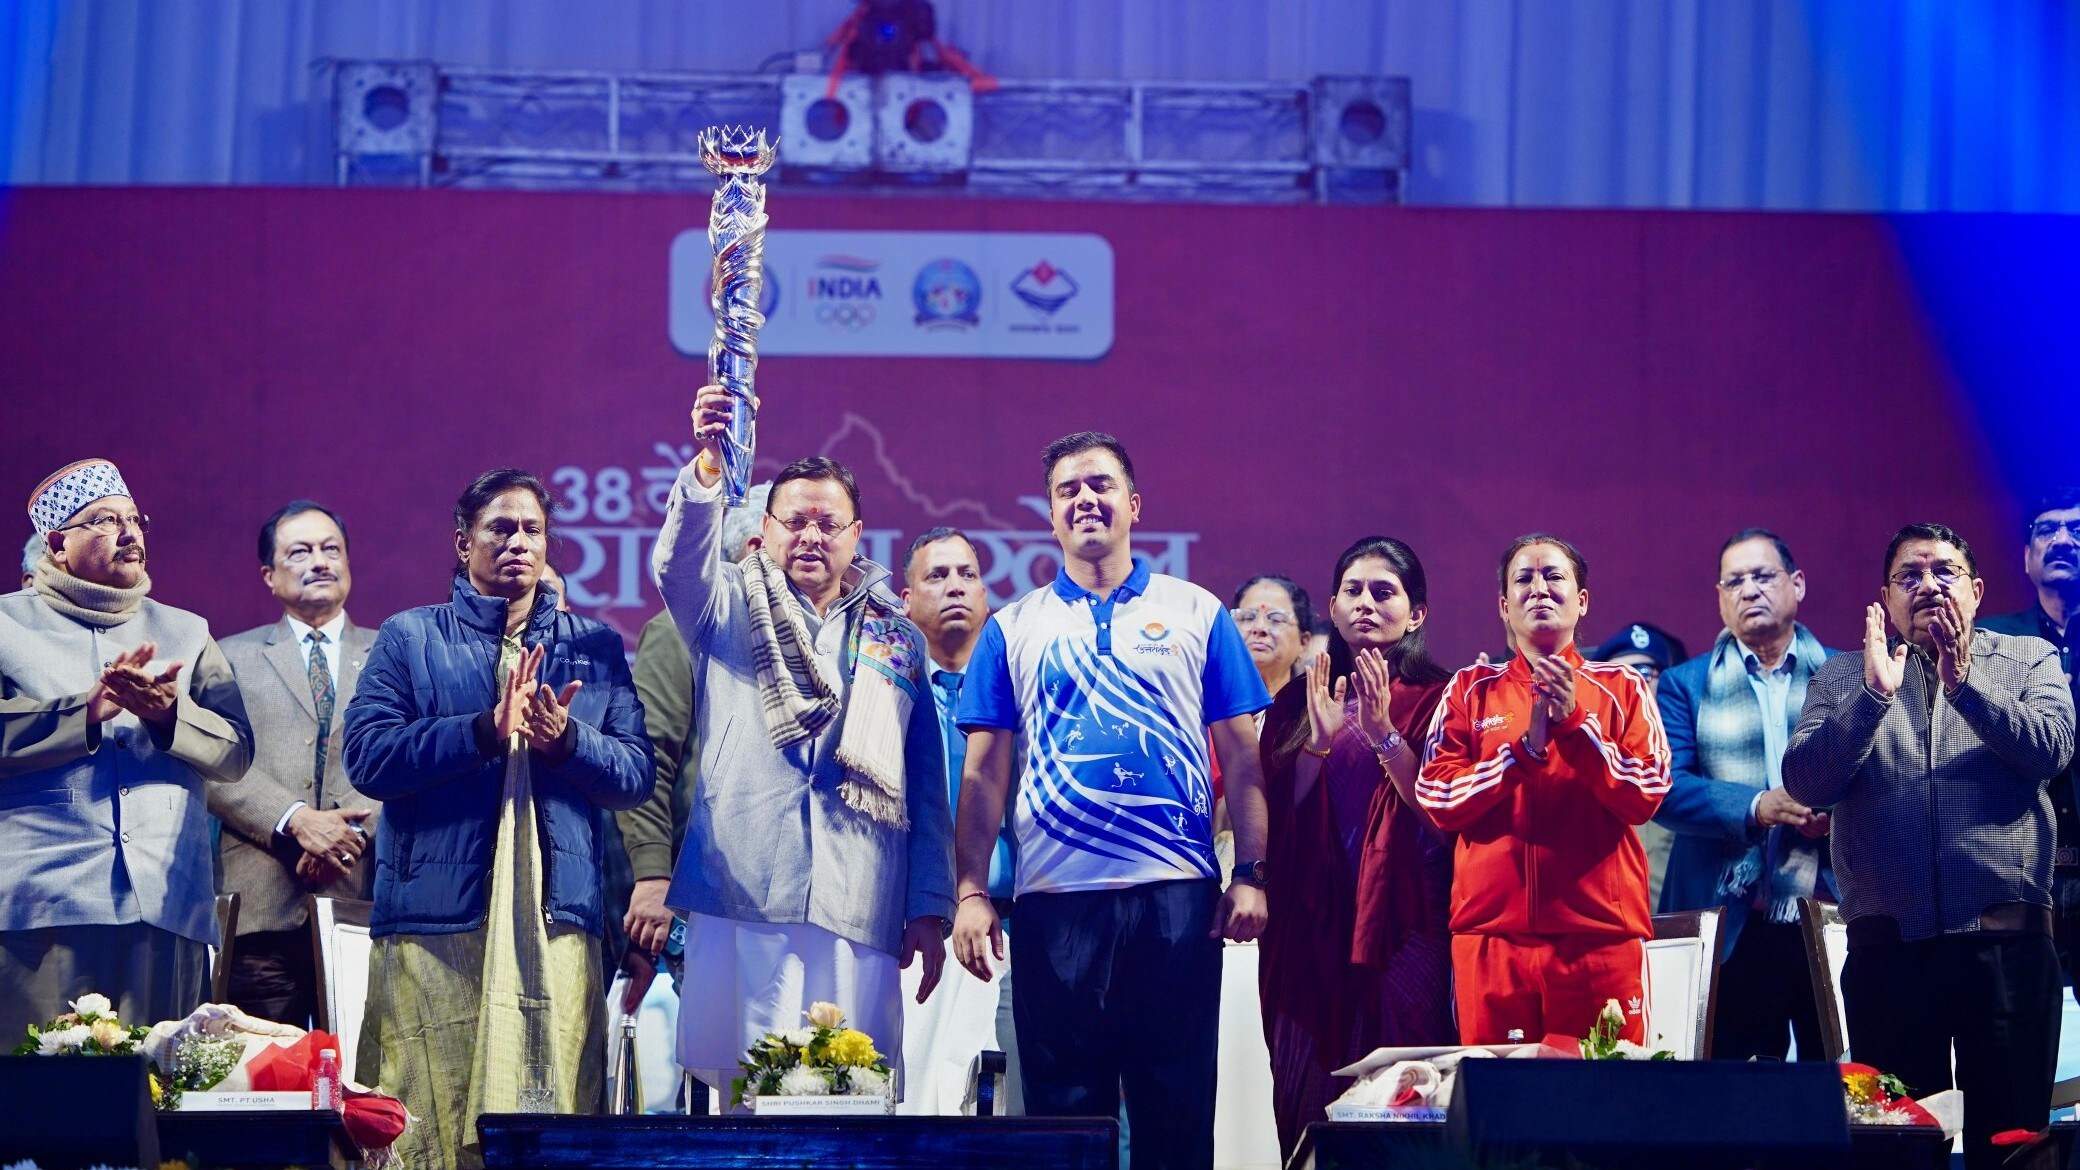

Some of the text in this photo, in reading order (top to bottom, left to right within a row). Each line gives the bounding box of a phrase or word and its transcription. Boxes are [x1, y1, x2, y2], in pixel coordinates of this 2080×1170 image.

[807, 277, 882, 299] INDIA
[552, 466, 632, 523] 38
[1358, 1111, 1391, 1119] RAKSHA
[1393, 1112, 1420, 1120] NIKHIL
